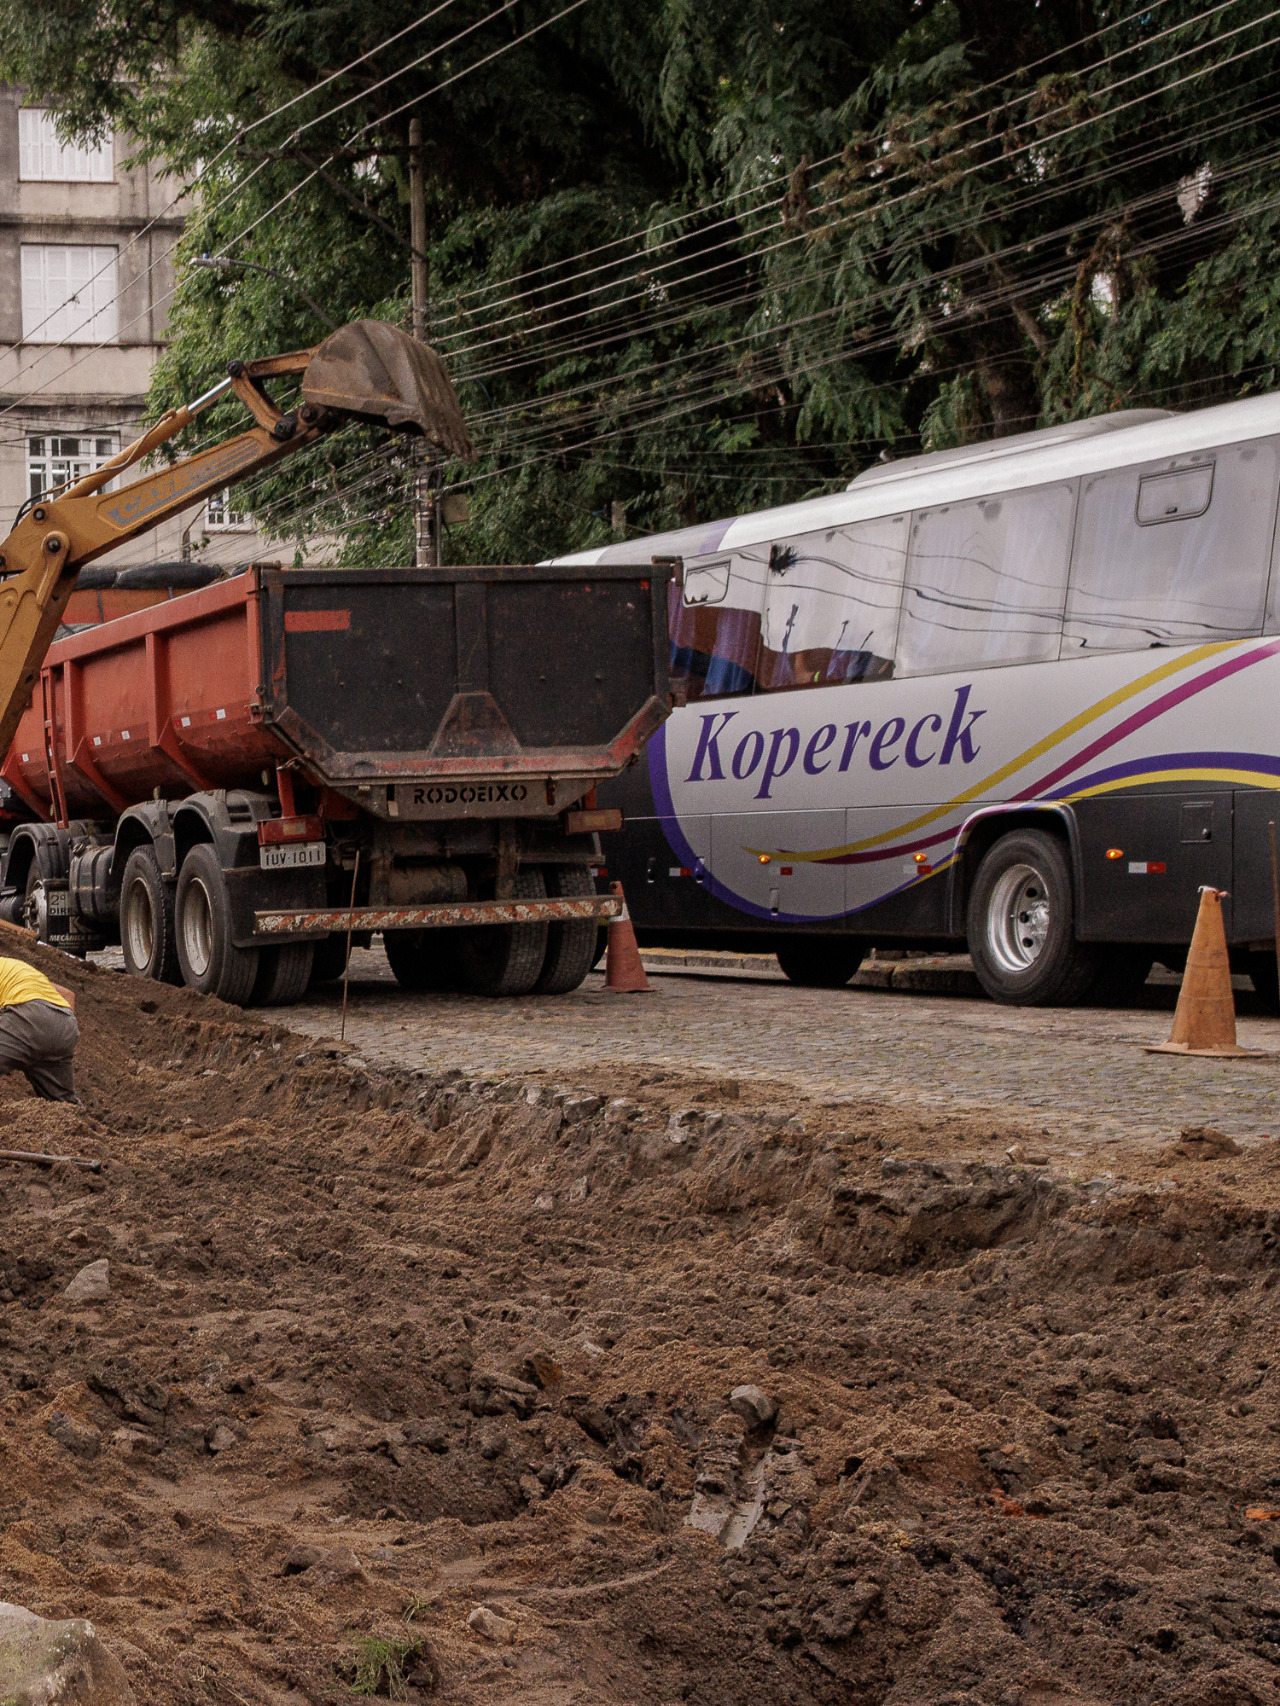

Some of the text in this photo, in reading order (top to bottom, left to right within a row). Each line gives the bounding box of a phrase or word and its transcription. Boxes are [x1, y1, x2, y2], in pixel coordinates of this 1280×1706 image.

[119, 464, 194, 521] CASE
[684, 684, 987, 799] Kopereck
[414, 785, 528, 804] RODOEIXO
